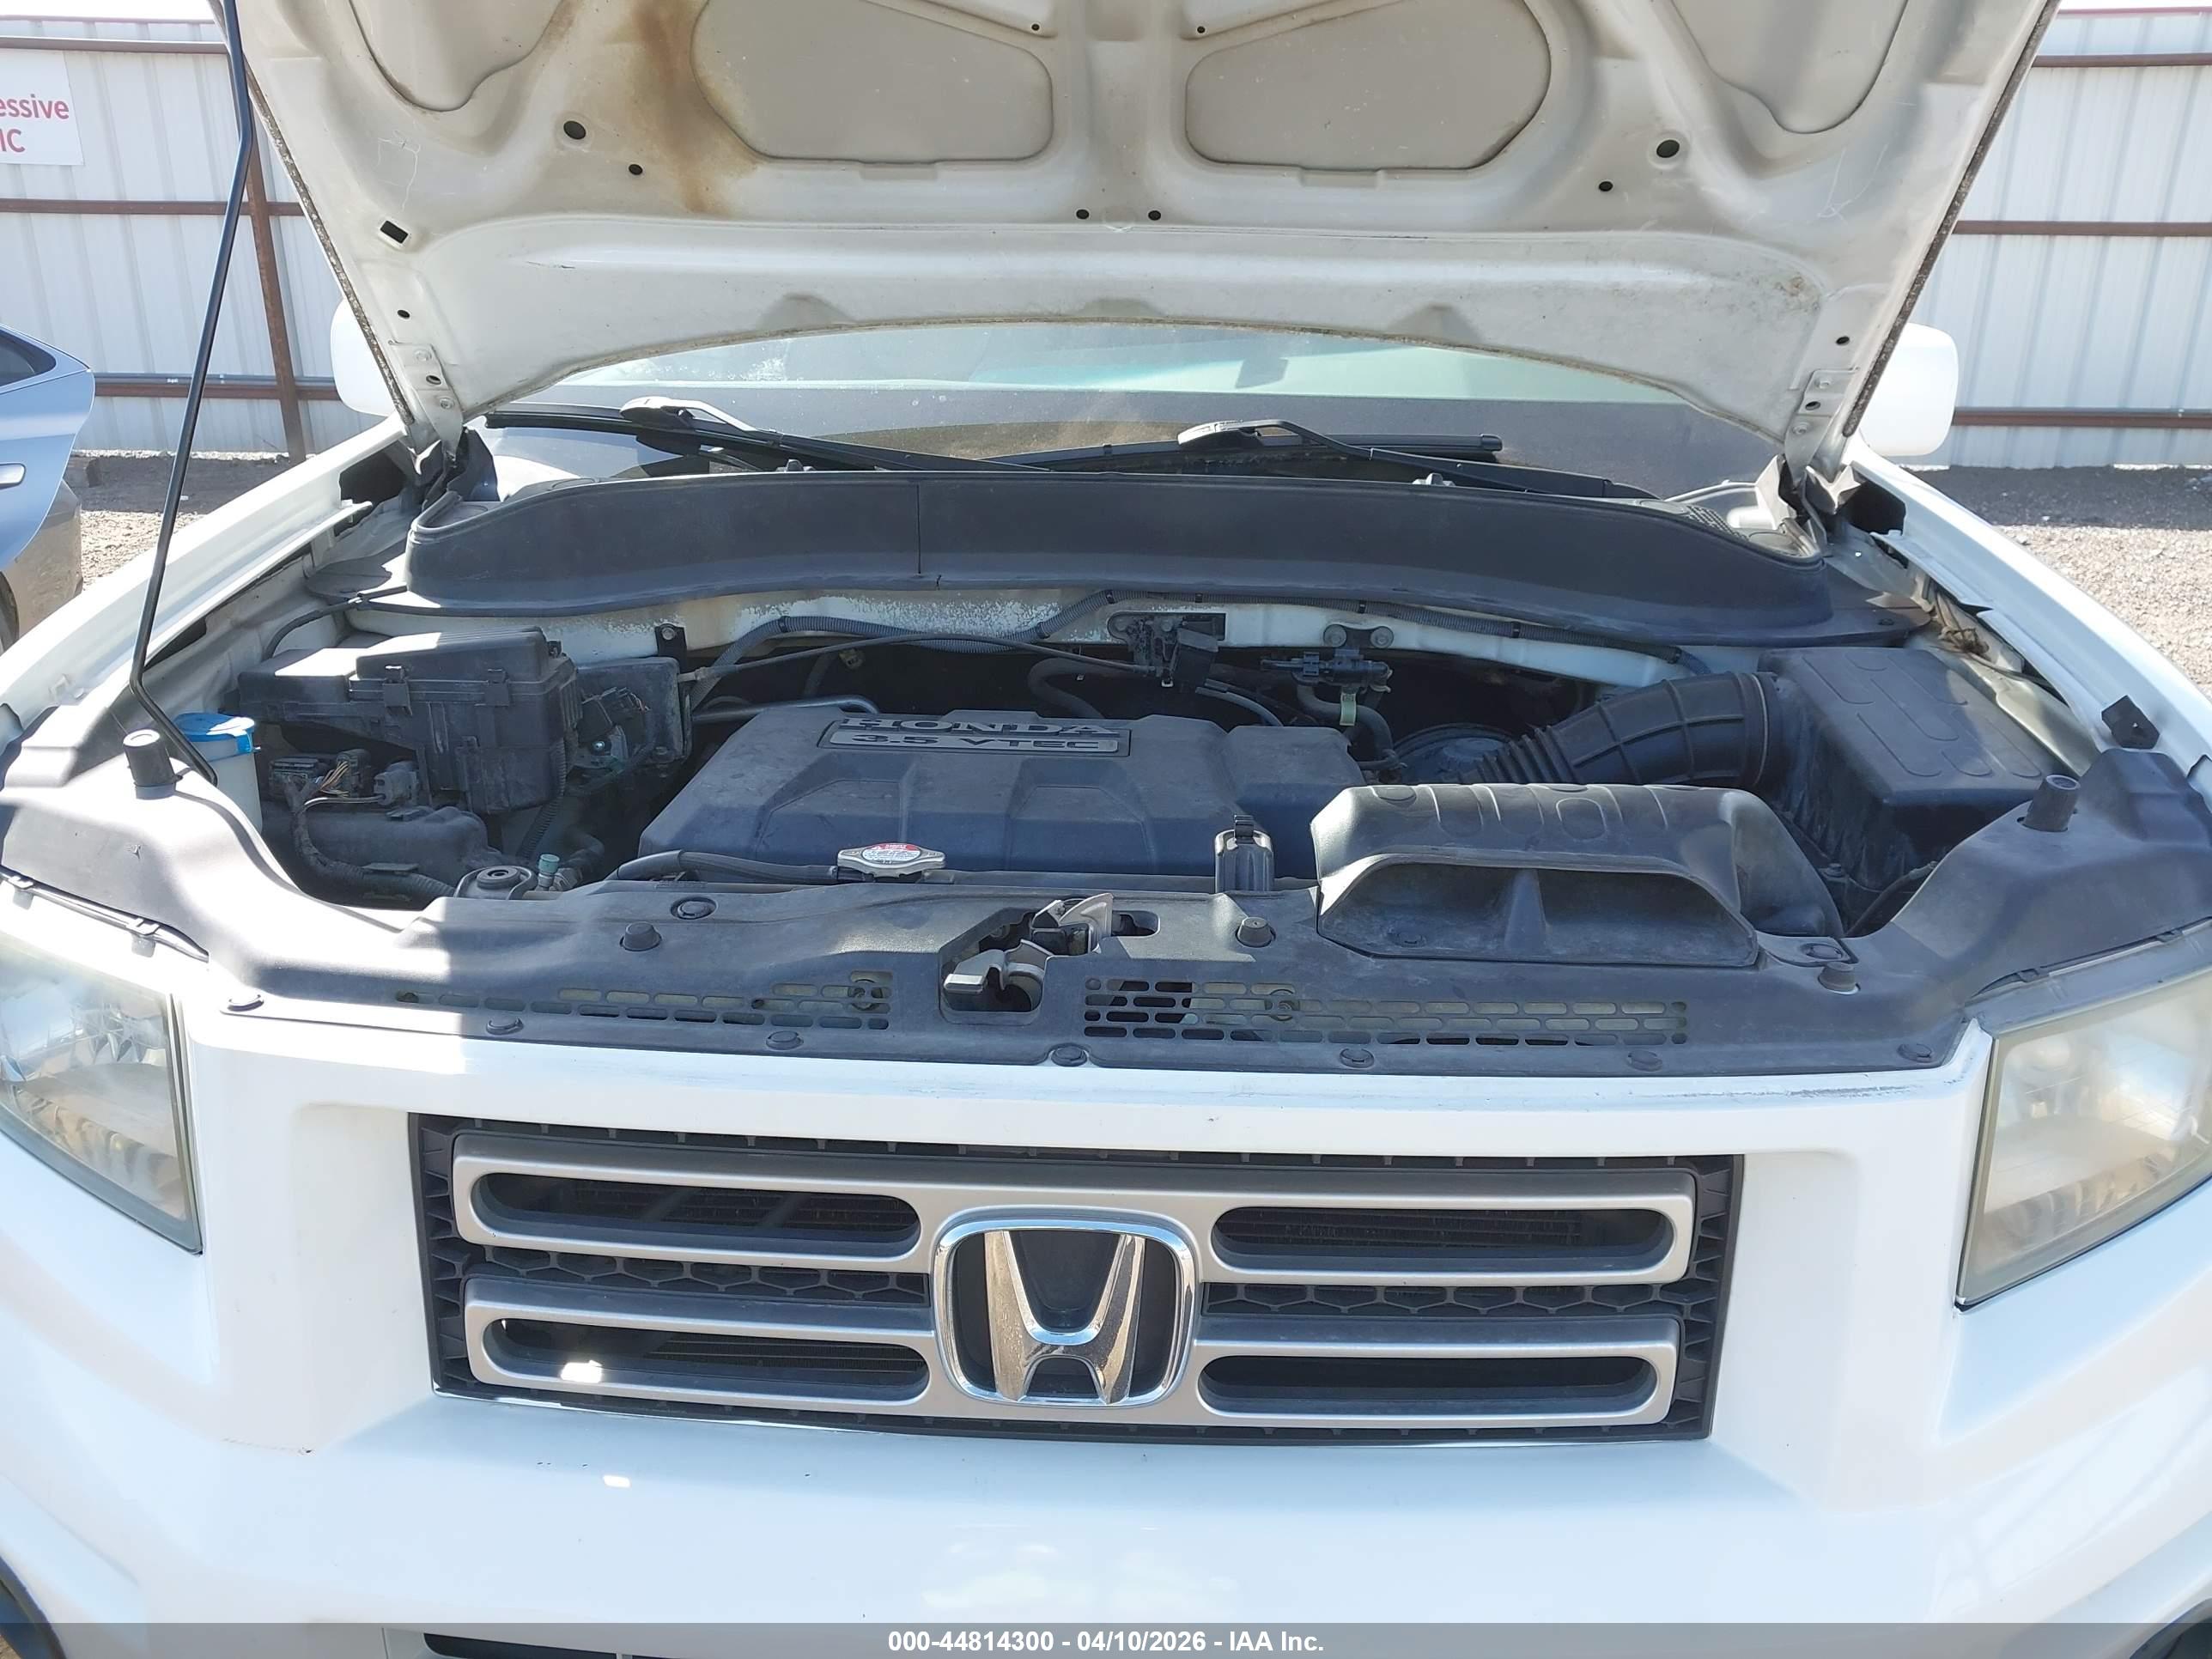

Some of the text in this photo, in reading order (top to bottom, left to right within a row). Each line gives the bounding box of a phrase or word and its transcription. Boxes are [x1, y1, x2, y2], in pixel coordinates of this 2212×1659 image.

[839, 717, 1120, 736] HONDA
[851, 734, 1100, 749] 3.5 VTEC
